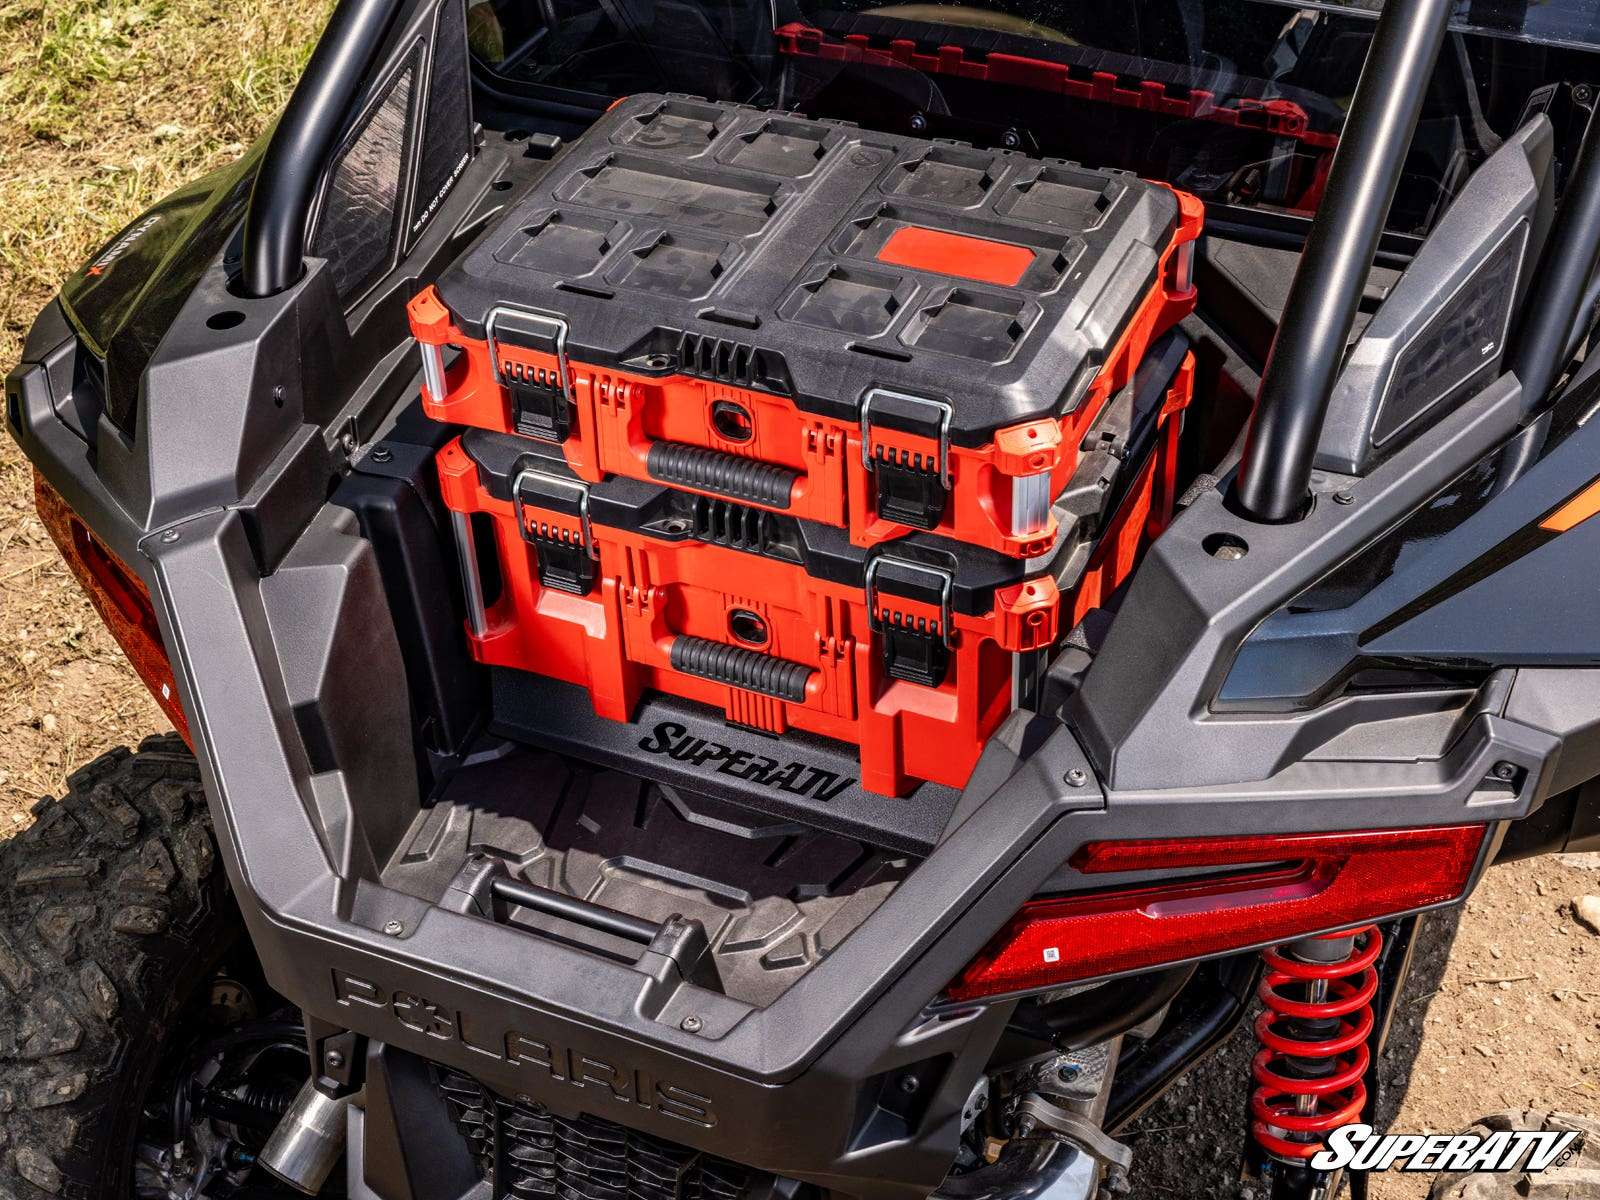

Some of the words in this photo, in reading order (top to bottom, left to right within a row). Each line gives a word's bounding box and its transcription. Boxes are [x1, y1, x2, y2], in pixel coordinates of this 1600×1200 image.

[421, 211, 429, 222] DO
[429, 196, 438, 211] NOT
[439, 176, 453, 197] COVER
[638, 721, 857, 801] SUPERATV
[331, 967, 720, 1129] POLARIS
